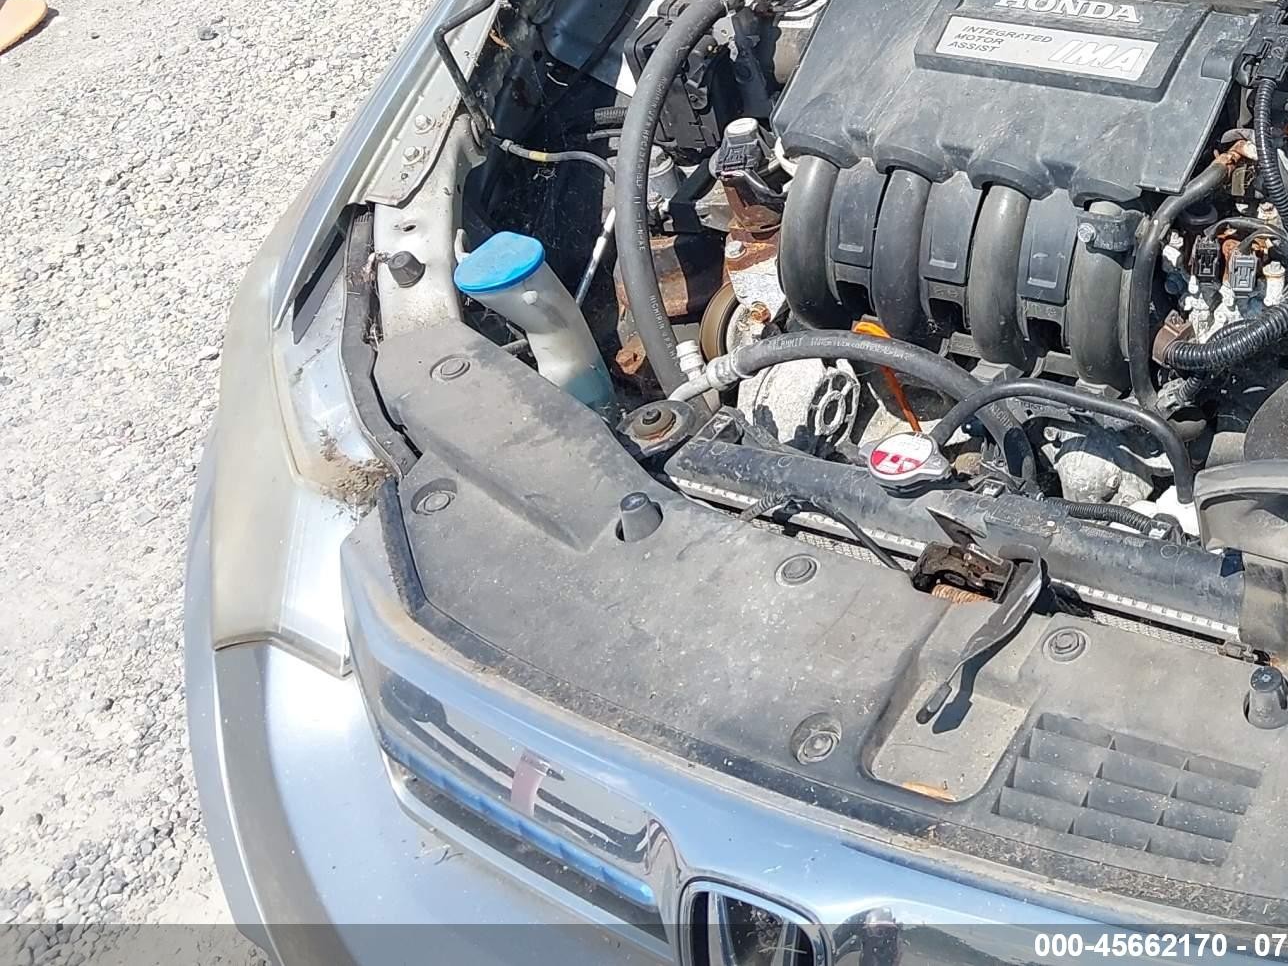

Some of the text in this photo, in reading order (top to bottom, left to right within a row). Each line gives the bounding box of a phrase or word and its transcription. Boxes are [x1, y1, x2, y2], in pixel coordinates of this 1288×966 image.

[954, 33, 1005, 46] MOTOR
[962, 25, 1053, 44] INTEGRATED
[947, 40, 1001, 53] ASSIST
